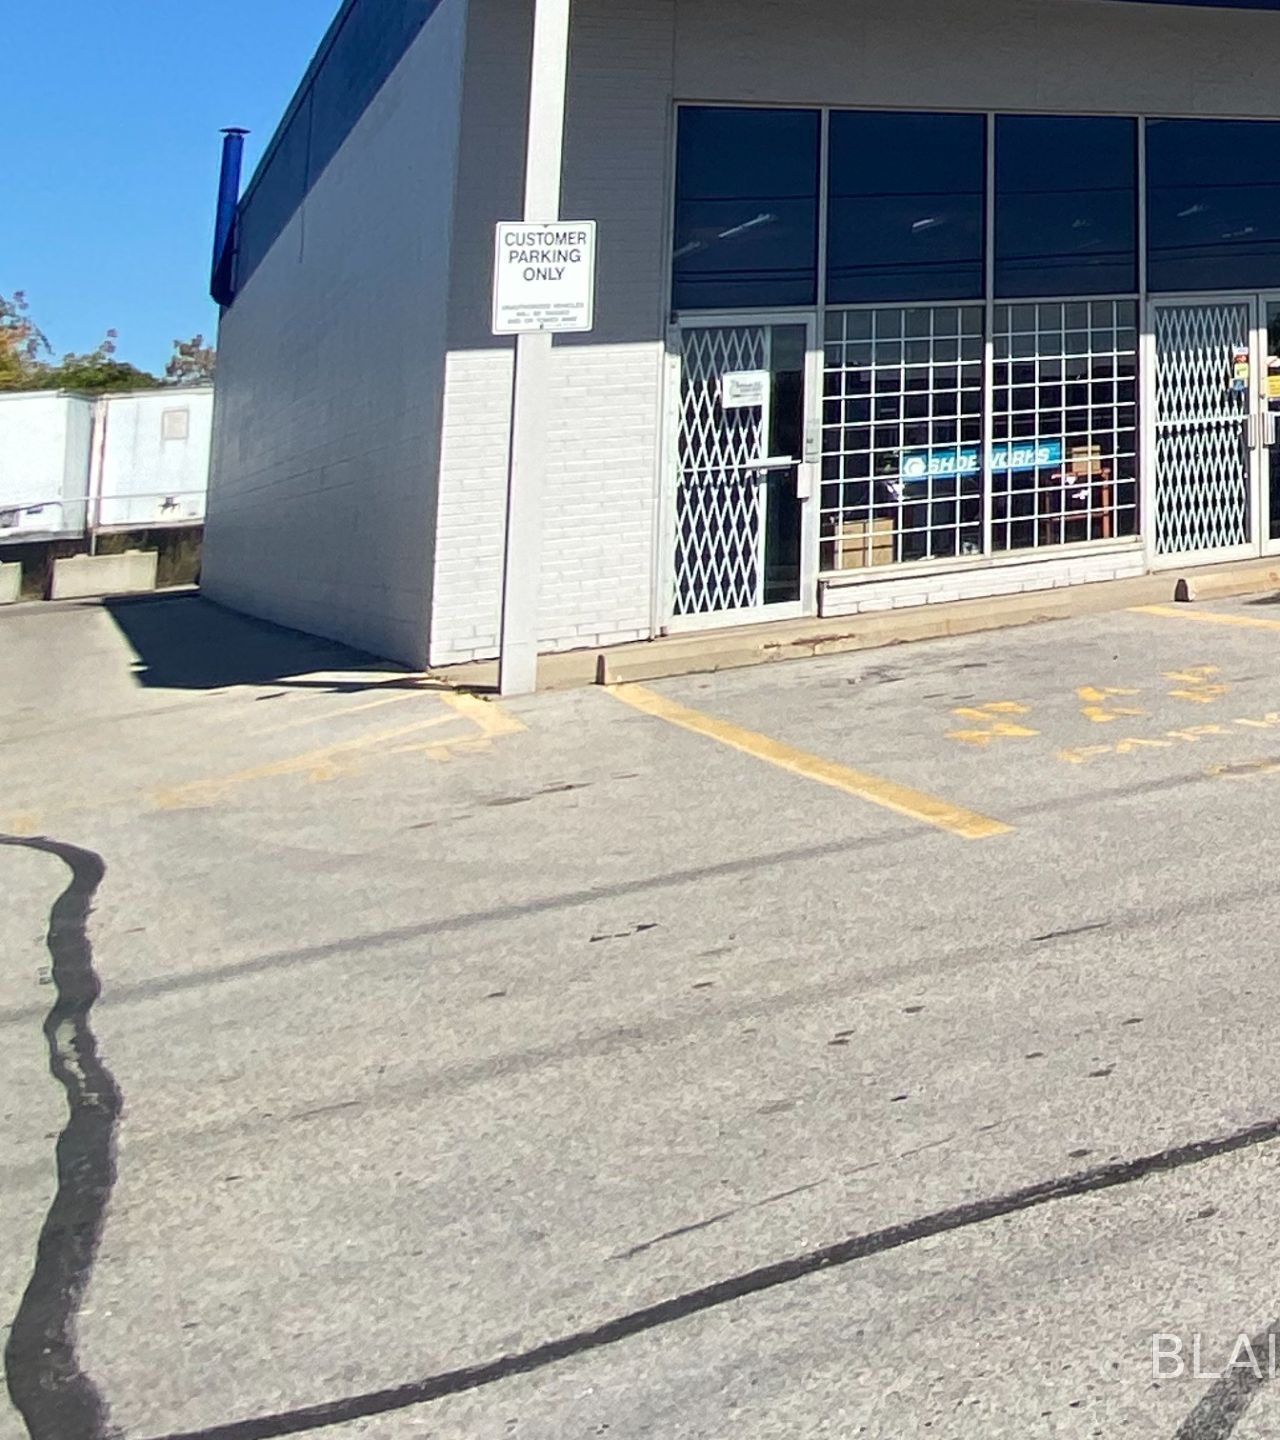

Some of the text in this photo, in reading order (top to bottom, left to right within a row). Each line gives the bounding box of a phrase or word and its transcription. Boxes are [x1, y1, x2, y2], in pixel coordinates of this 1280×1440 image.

[504, 231, 587, 247] CUSTOMER
[508, 248, 582, 264] PARKING
[523, 266, 566, 282] ONLY
